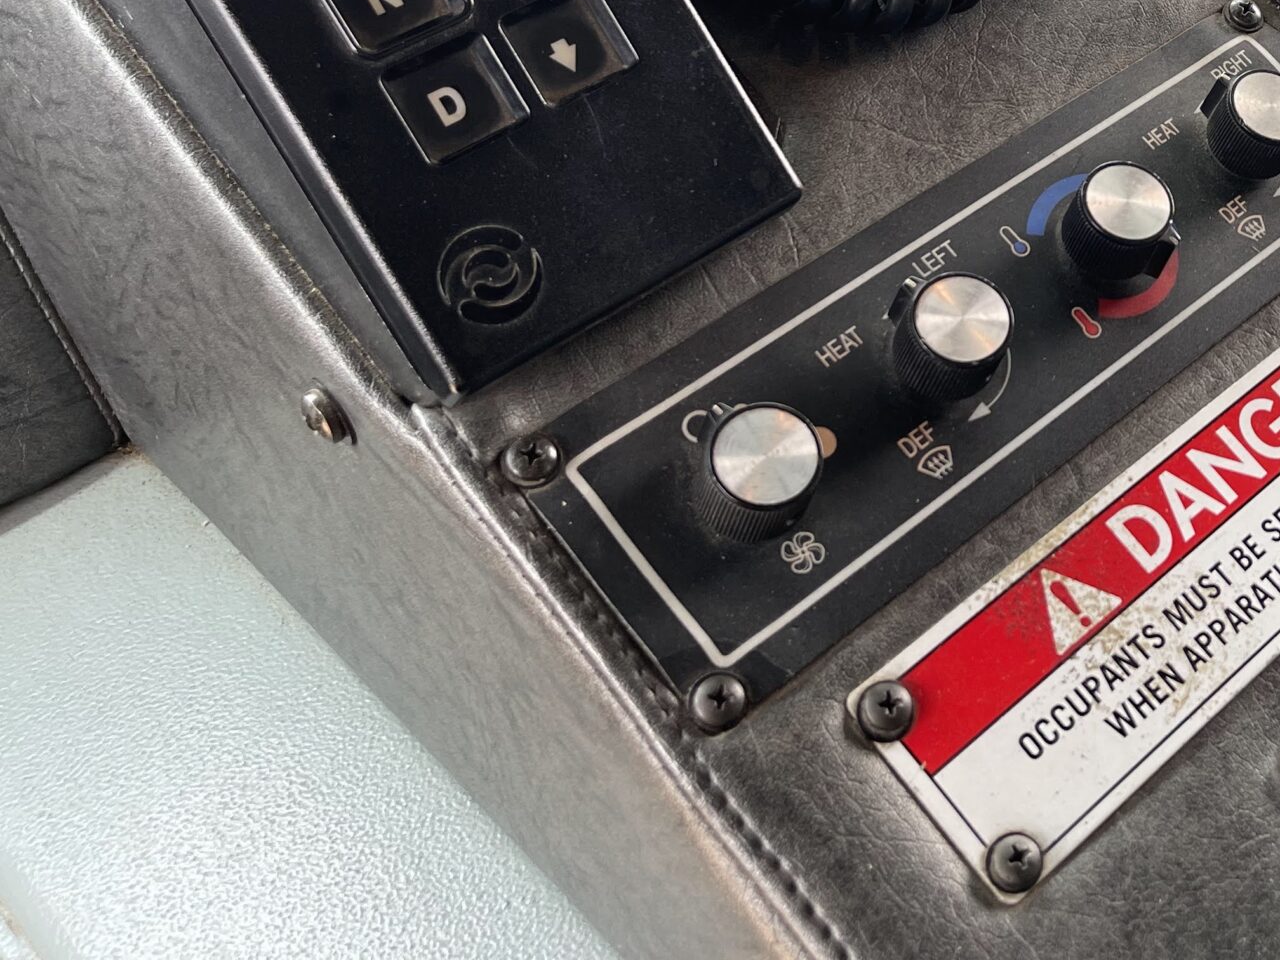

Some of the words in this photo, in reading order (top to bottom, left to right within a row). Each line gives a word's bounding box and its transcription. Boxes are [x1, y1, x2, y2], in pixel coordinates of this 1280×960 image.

[1210, 49, 1252, 80] RIGHT
[427, 86, 467, 127] D
[1142, 118, 1180, 150] HEAT
[1219, 195, 1248, 224] DEF
[912, 240, 957, 277] LEFT
[815, 325, 863, 368] HEAT
[897, 421, 934, 458] DEF
[1018, 624, 1166, 760] OCCUPANTS
[1162, 561, 1233, 632] MUST
[1229, 534, 1266, 572] BE
[1103, 663, 1186, 738] WHEN
